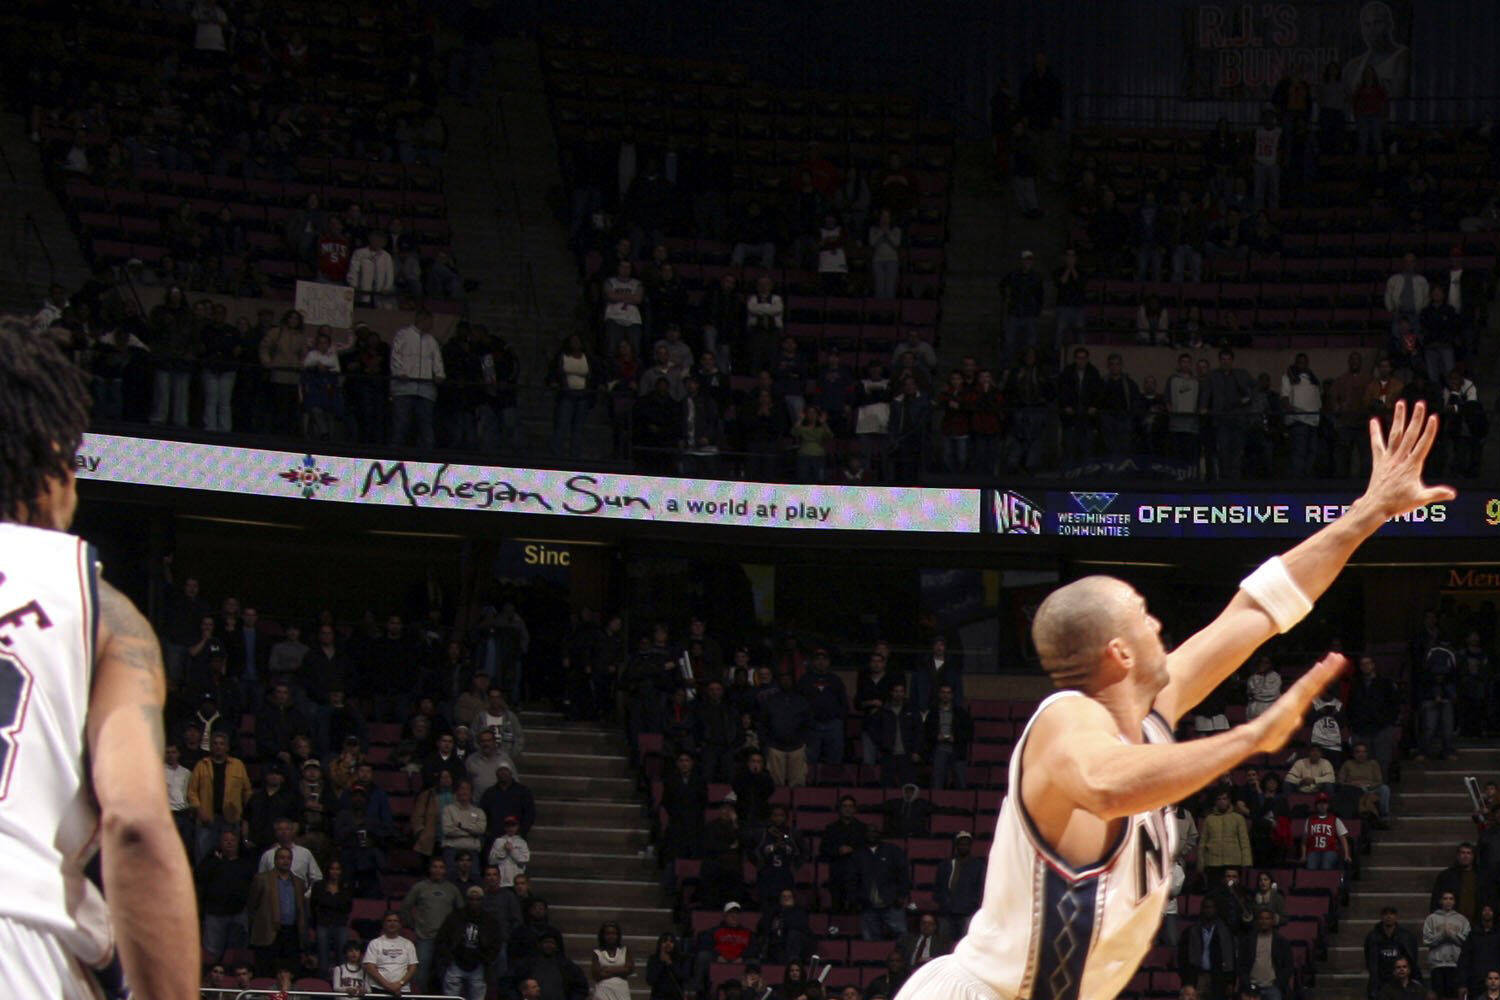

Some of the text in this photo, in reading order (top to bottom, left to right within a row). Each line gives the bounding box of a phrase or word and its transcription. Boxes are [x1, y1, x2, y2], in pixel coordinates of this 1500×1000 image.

[360, 461, 832, 523] Mohegan Sun a world at play
[994, 490, 1043, 534] NETS
[1057, 512, 1132, 524] WESTMINSTER
[1138, 505, 1290, 524] OFFENSIVE
[1305, 505, 1447, 523] RENDS
[1058, 525, 1131, 537] COMMUNITIES
[1310, 823, 1333, 836] NETS
[1314, 836, 1327, 848] 15
